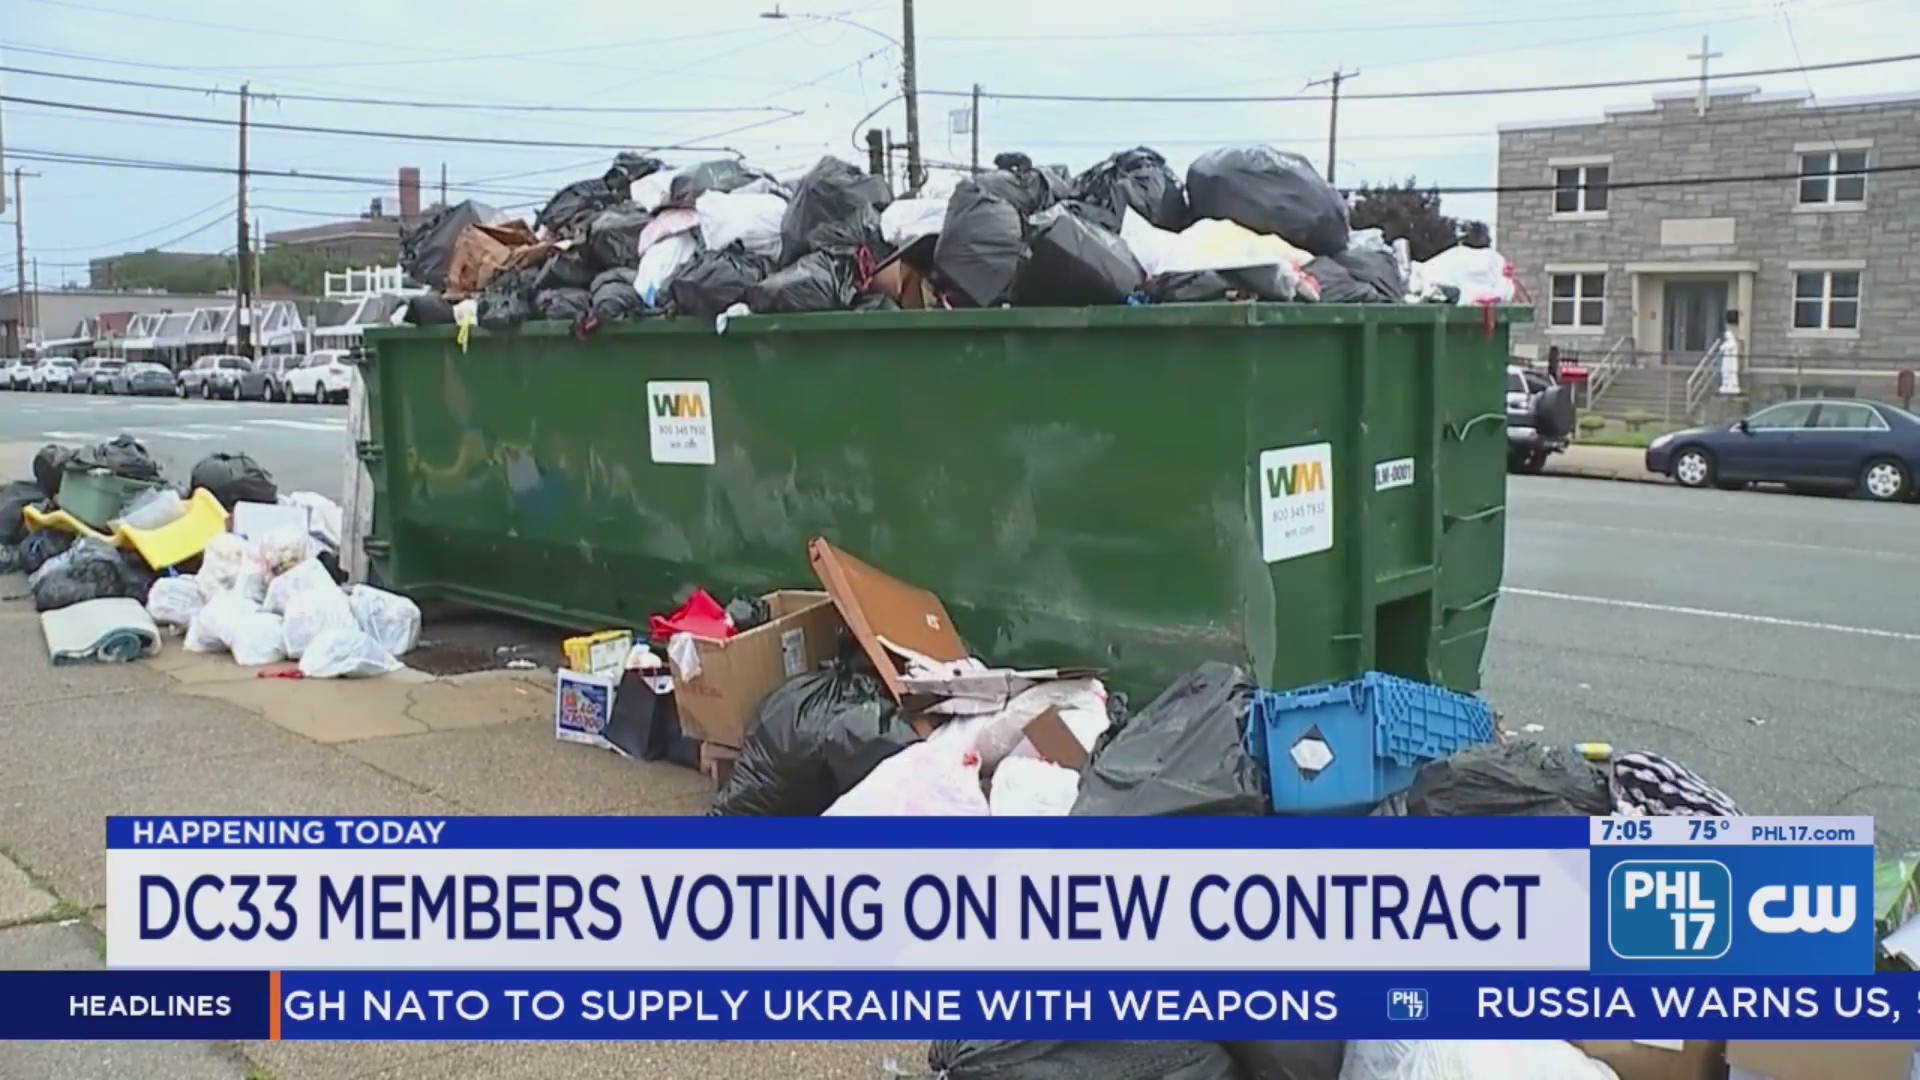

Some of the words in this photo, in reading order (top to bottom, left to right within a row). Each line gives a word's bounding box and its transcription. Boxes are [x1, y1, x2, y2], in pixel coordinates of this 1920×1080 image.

[653, 394, 705, 418] WM
[1267, 461, 1324, 498] WM
[1273, 509, 1288, 522] 800
[1290, 506, 1305, 519] 345
